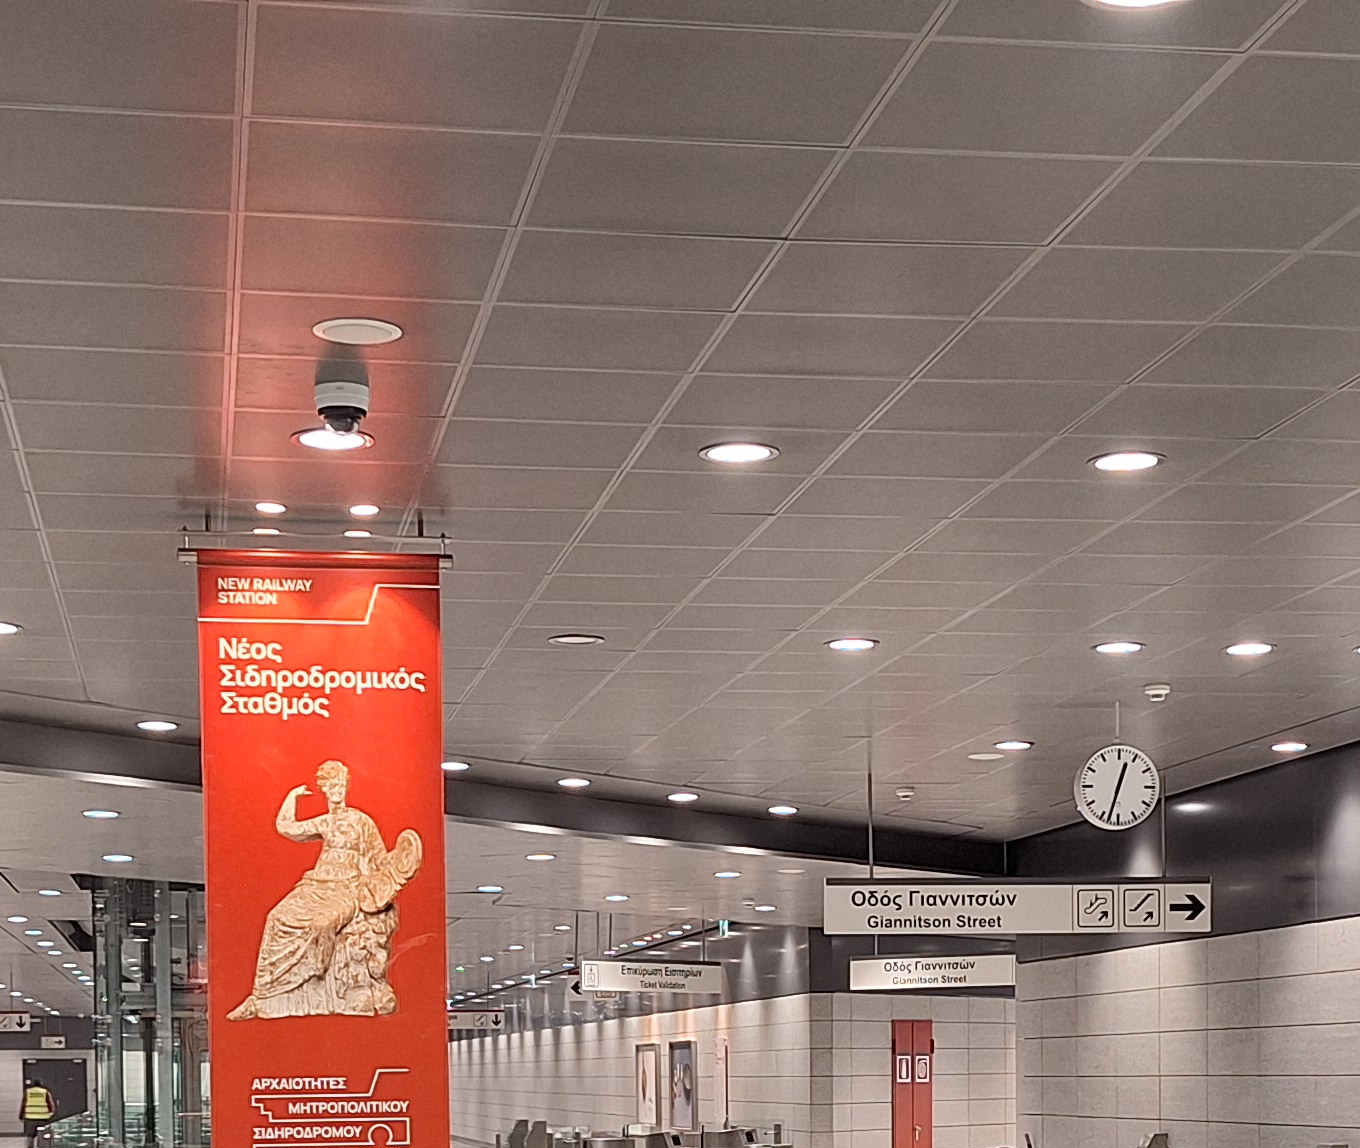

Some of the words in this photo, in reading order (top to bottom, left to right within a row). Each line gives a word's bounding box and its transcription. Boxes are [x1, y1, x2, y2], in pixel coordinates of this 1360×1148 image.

[217, 577, 250, 590] NEW
[253, 578, 313, 592] RAILWAY
[218, 591, 278, 605] STATION
[218, 637, 283, 663] Νέος
[219, 664, 427, 694] Σιδηροδρομικός
[220, 691, 330, 720] Σταθμός
[851, 890, 902, 910] Οδός
[909, 889, 1017, 907] Γιαννιτσών
[867, 915, 951, 928] Giannitson
[956, 915, 1002, 928] Street
[884, 961, 911, 973] Οδός
[915, 959, 976, 971] Γιαννιτσών
[640, 980, 657, 988] Ticket
[658, 981, 686, 989] Validation
[892, 976, 939, 985] Giannitson
[941, 975, 967, 984] Street
[251, 1077, 347, 1090] ΑΡΧΑΙΟΤΗΤΕΣ
[288, 1101, 409, 1114] ΜΗΤΡΟΠΟΛΙΤΙΚΟΥ
[252, 1126, 362, 1139] ΣΙΔΗΡΟΔΡΟΜΟΥ
